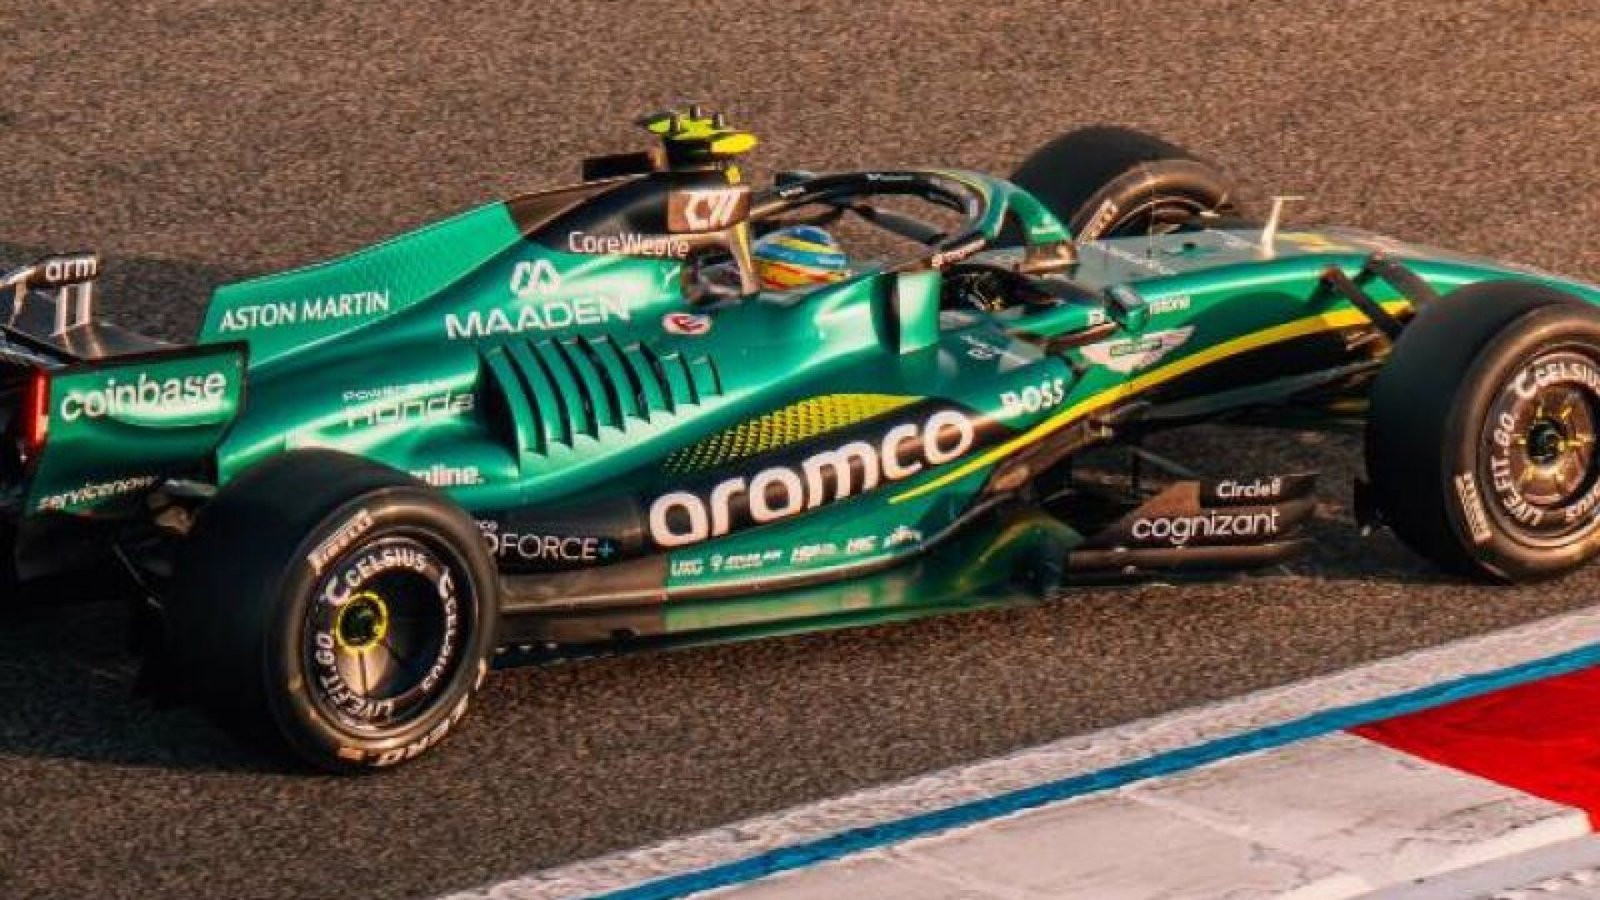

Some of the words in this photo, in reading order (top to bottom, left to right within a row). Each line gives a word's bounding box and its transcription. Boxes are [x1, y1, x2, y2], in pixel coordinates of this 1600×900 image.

[45, 257, 97, 281] arm
[220, 303, 297, 332] ASTON
[303, 290, 390, 321] MARTIN
[445, 294, 630, 339] MAADEN
[60, 371, 227, 423] coinbase
[649, 410, 976, 548] aramco
[1131, 508, 1281, 545] cognizant
